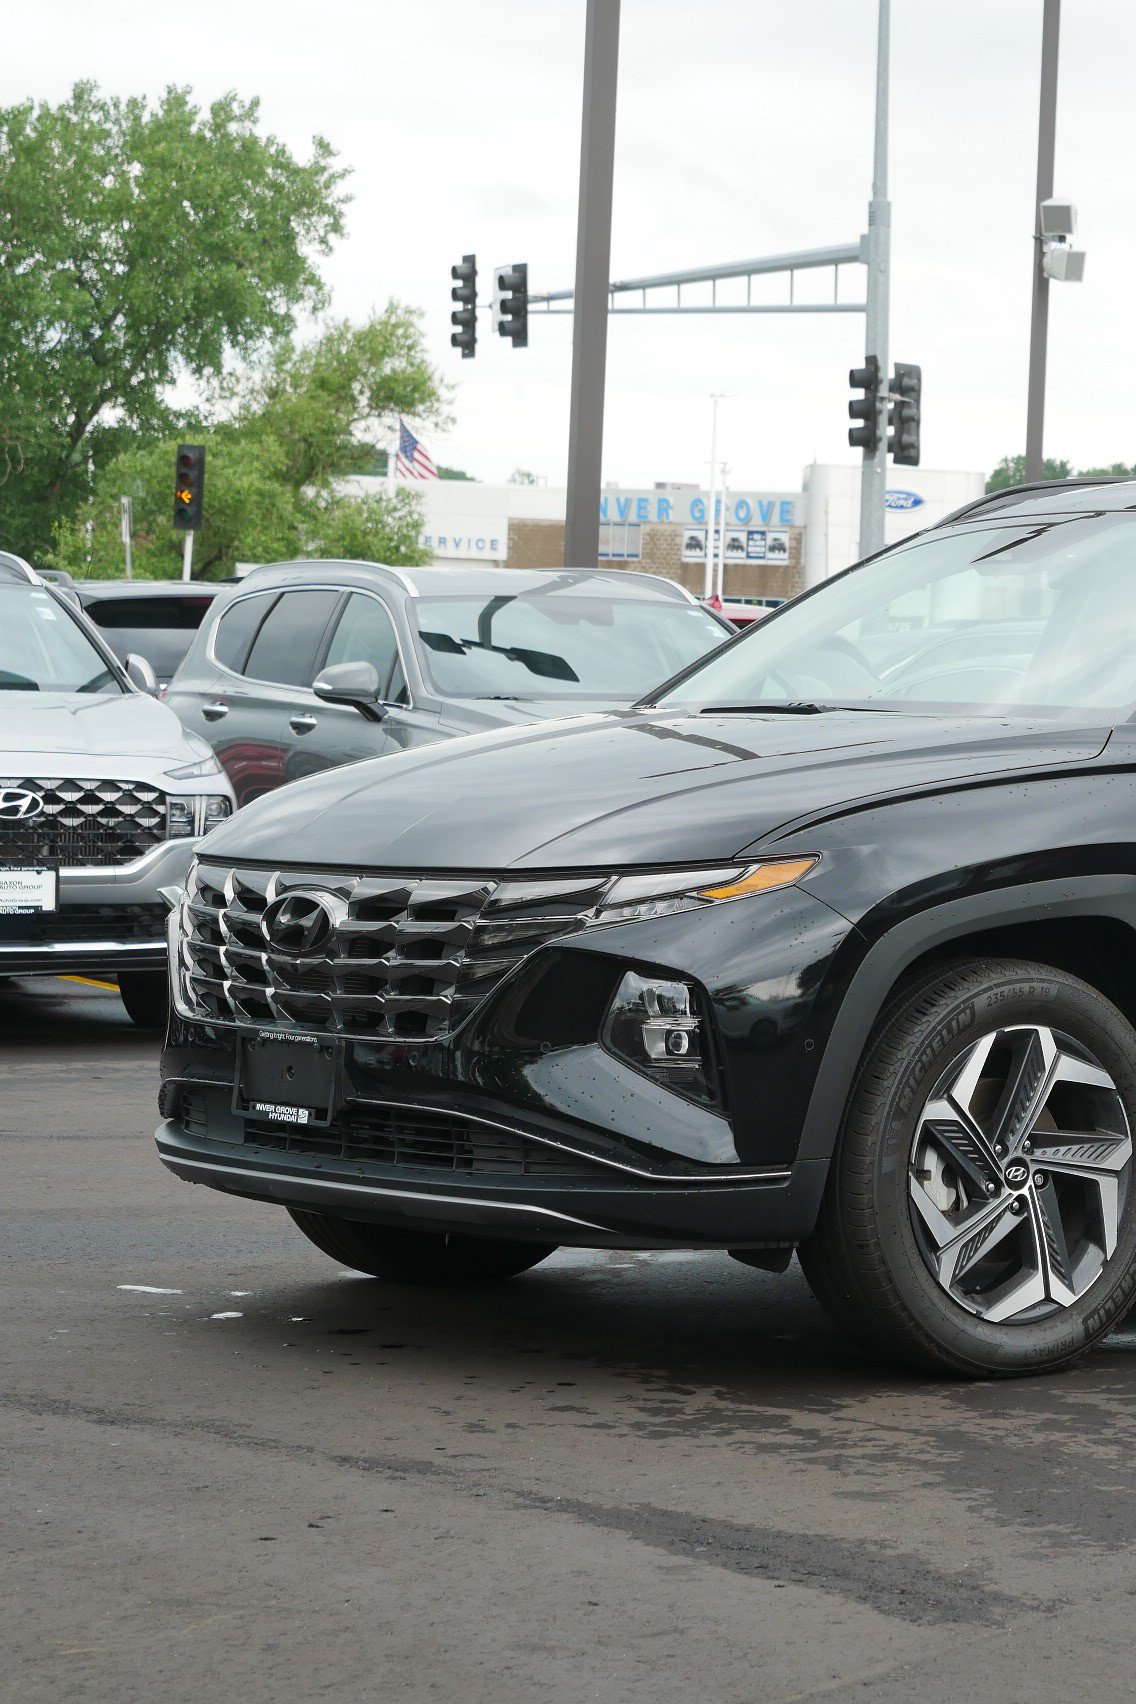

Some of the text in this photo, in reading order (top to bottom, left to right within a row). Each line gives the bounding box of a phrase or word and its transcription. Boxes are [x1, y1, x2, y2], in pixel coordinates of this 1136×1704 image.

[416, 535, 499, 551] ERVICE
[256, 1103, 298, 1115] INVER GROVE
[268, 1112, 298, 1122] HYUNDAI
